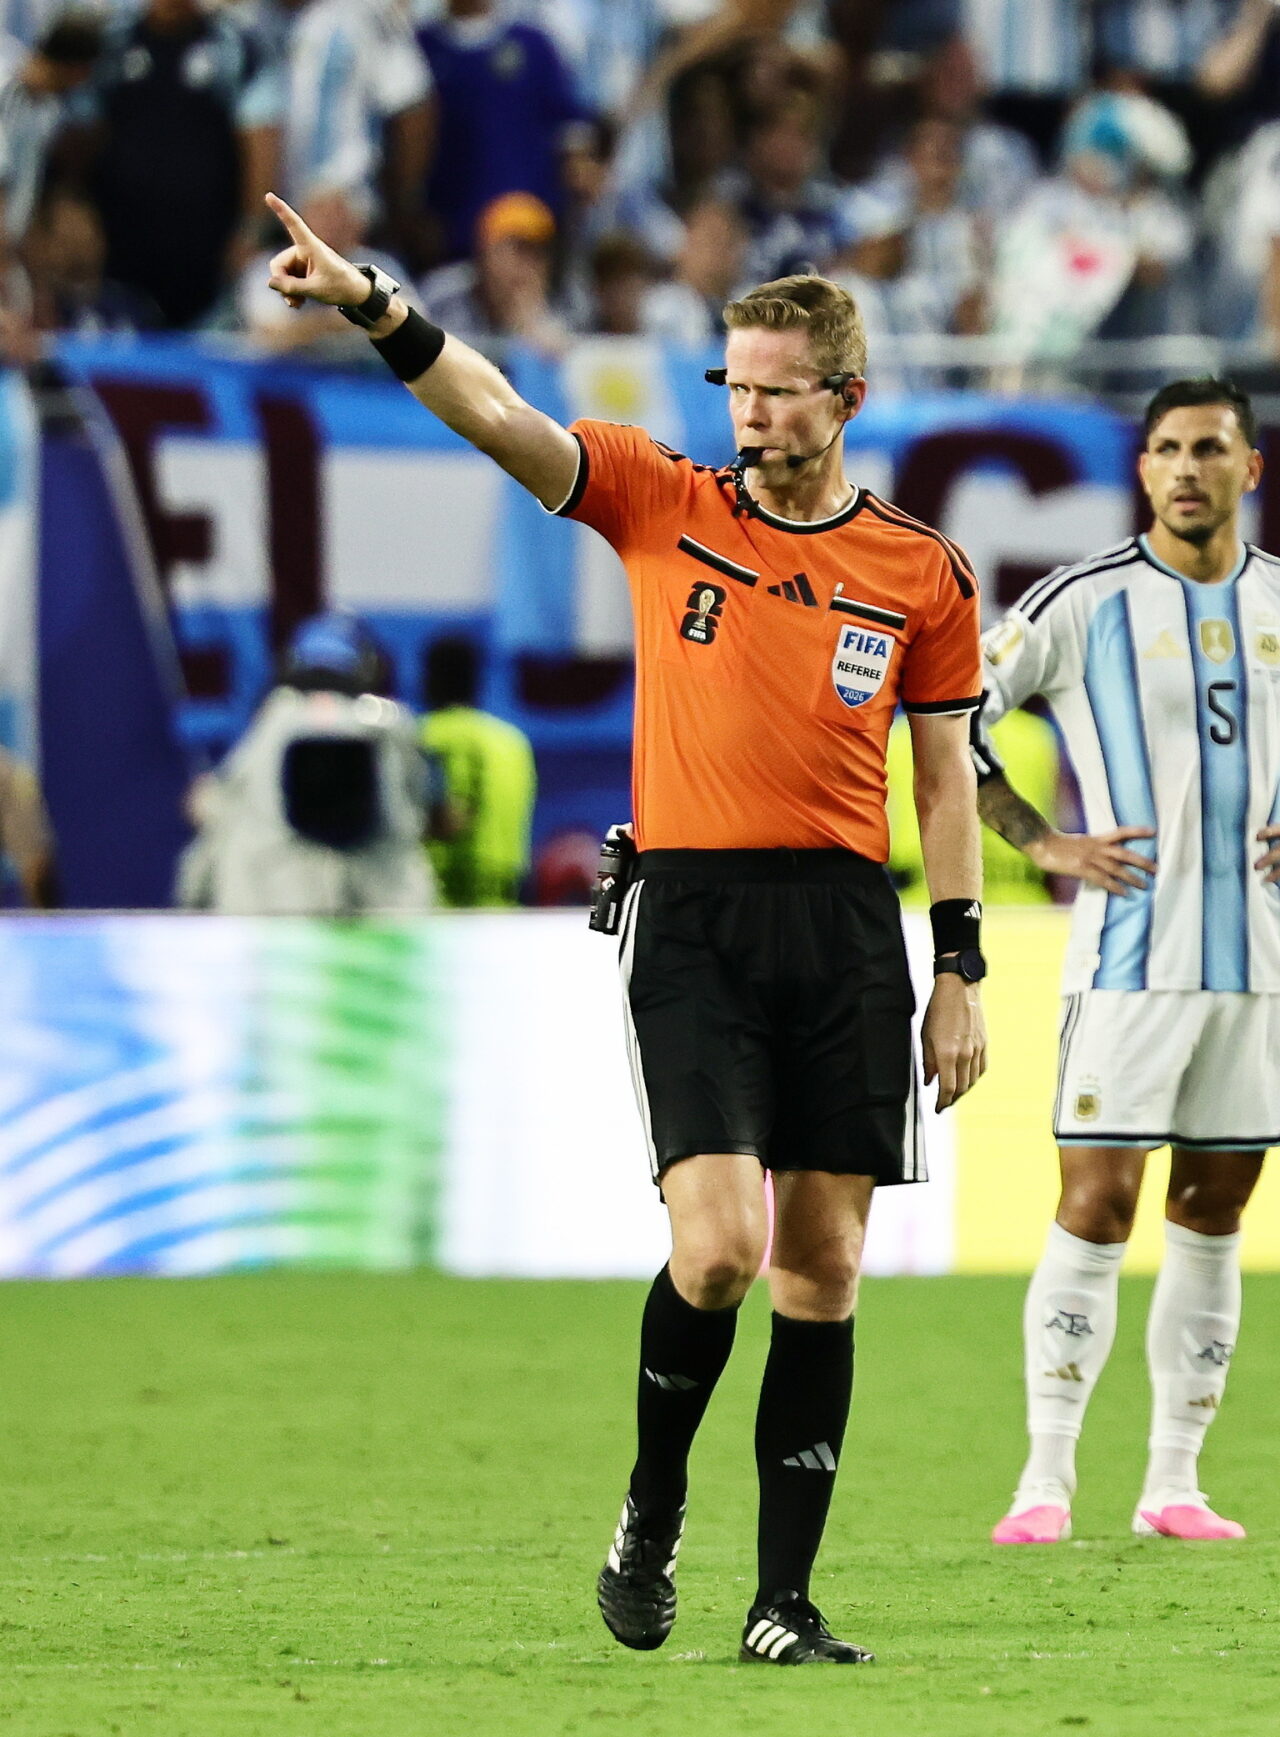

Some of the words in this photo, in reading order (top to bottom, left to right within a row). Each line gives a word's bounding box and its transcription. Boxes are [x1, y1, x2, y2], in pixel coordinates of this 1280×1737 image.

[843, 630, 887, 658] FIFA
[837, 660, 882, 680] REFEREE
[843, 689, 865, 702] 2026
[1207, 682, 1237, 745] 5
